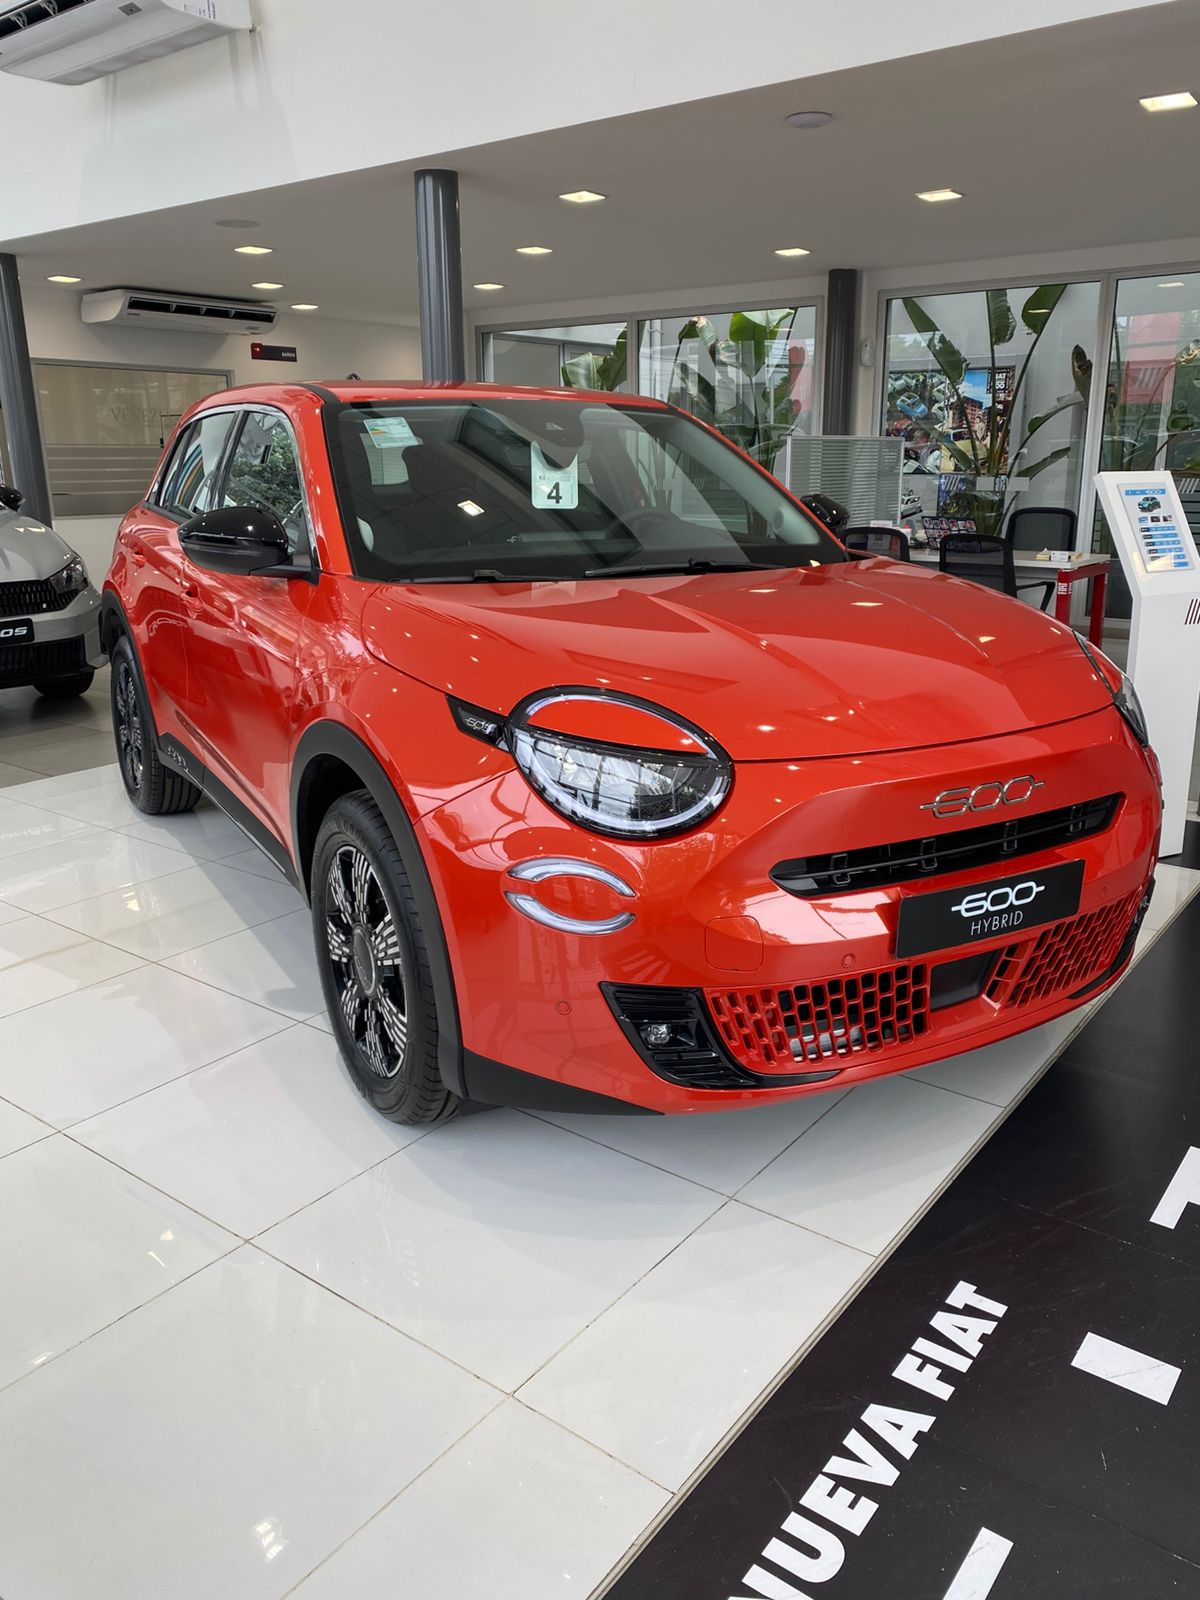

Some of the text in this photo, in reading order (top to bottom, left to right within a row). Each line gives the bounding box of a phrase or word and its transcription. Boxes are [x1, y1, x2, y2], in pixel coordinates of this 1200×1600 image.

[546, 481, 563, 504] 4
[919, 774, 1046, 819] 600
[951, 881, 1045, 918] 600
[970, 910, 1023, 936] HYBRID
[891, 1280, 1008, 1401] FIAT
